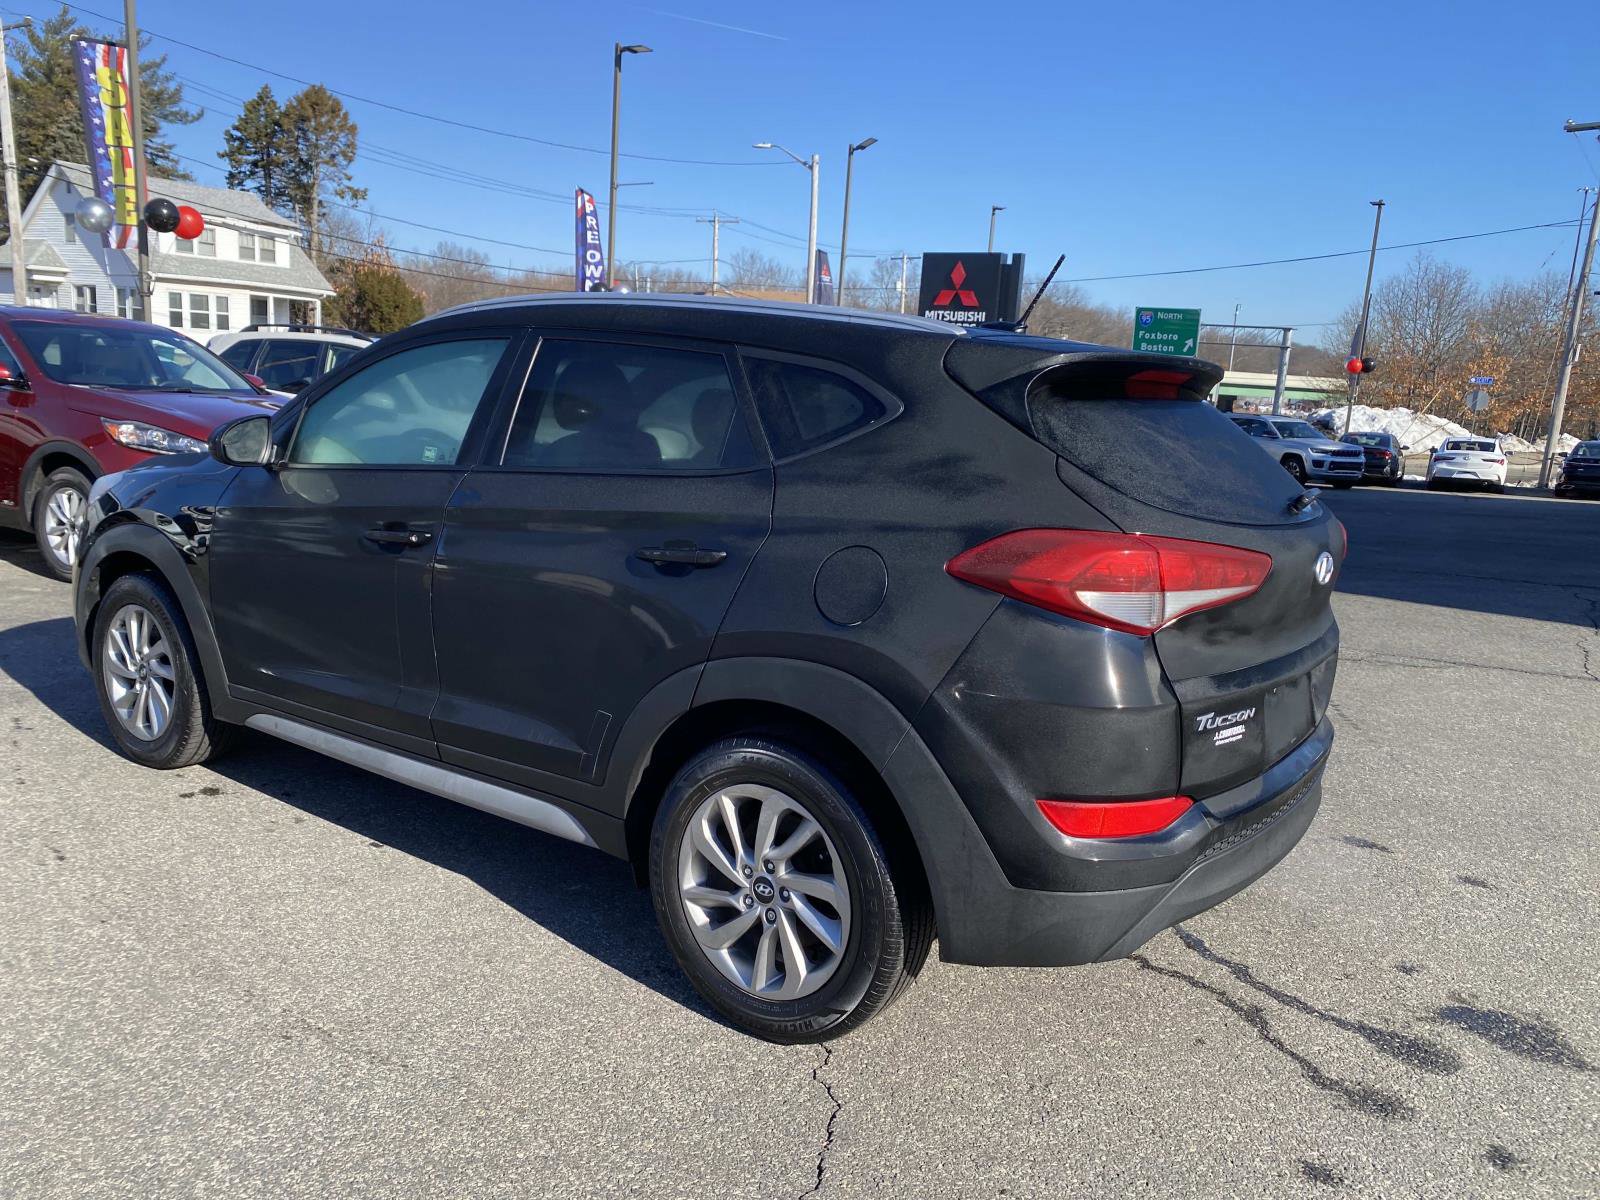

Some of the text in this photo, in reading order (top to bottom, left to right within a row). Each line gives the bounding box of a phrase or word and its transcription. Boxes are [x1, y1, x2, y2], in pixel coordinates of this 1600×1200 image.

[97, 66, 139, 226] SALE
[584, 193, 599, 244] PRE
[925, 310, 986, 322] MITSUBISHI
[1141, 311, 1183, 323] 95 NORTH
[1138, 330, 1179, 341] Foxboro
[1140, 342, 1174, 352] Boston
[1196, 707, 1256, 731] TUCSON
